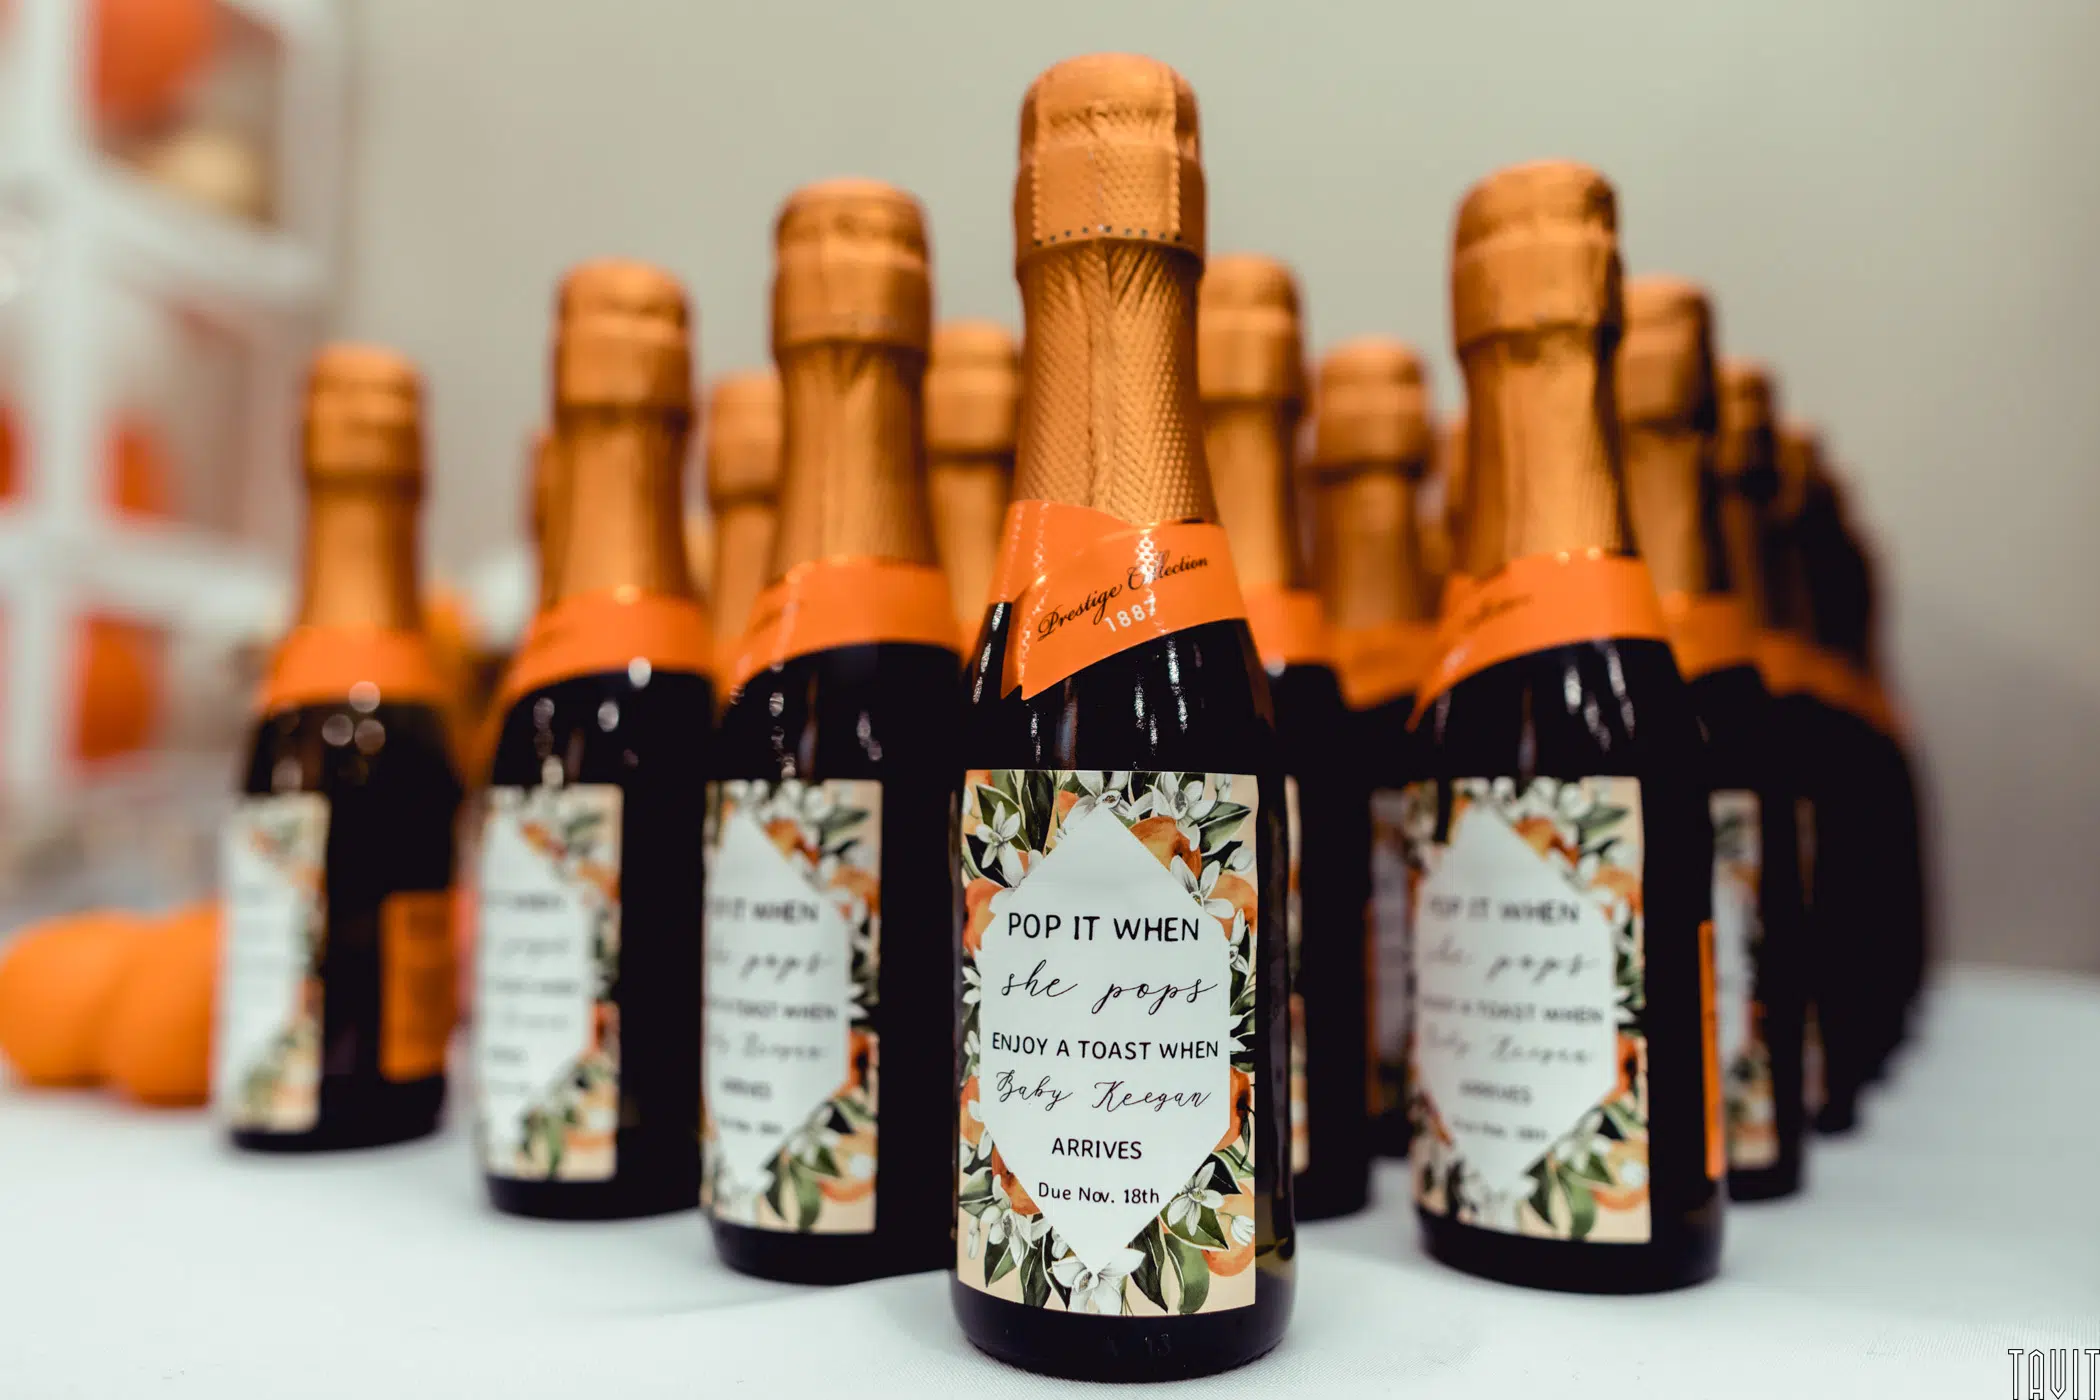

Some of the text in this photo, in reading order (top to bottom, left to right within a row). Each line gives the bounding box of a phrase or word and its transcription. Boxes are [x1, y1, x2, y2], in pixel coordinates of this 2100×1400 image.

[1037, 549, 1208, 641] Prestige Cllection
[1104, 598, 1157, 632] 1887
[1007, 912, 1199, 942] POP IT WHEN
[1502, 901, 1581, 925] WHEN
[1001, 959, 1218, 1015] she pops
[992, 1031, 1219, 1060] ENJOY A TOAST WHEN
[996, 1069, 1212, 1112] Baby Keegan
[1051, 1137, 1142, 1160] ARRIVES
[1038, 1181, 1160, 1204] Due Nov. 18th
